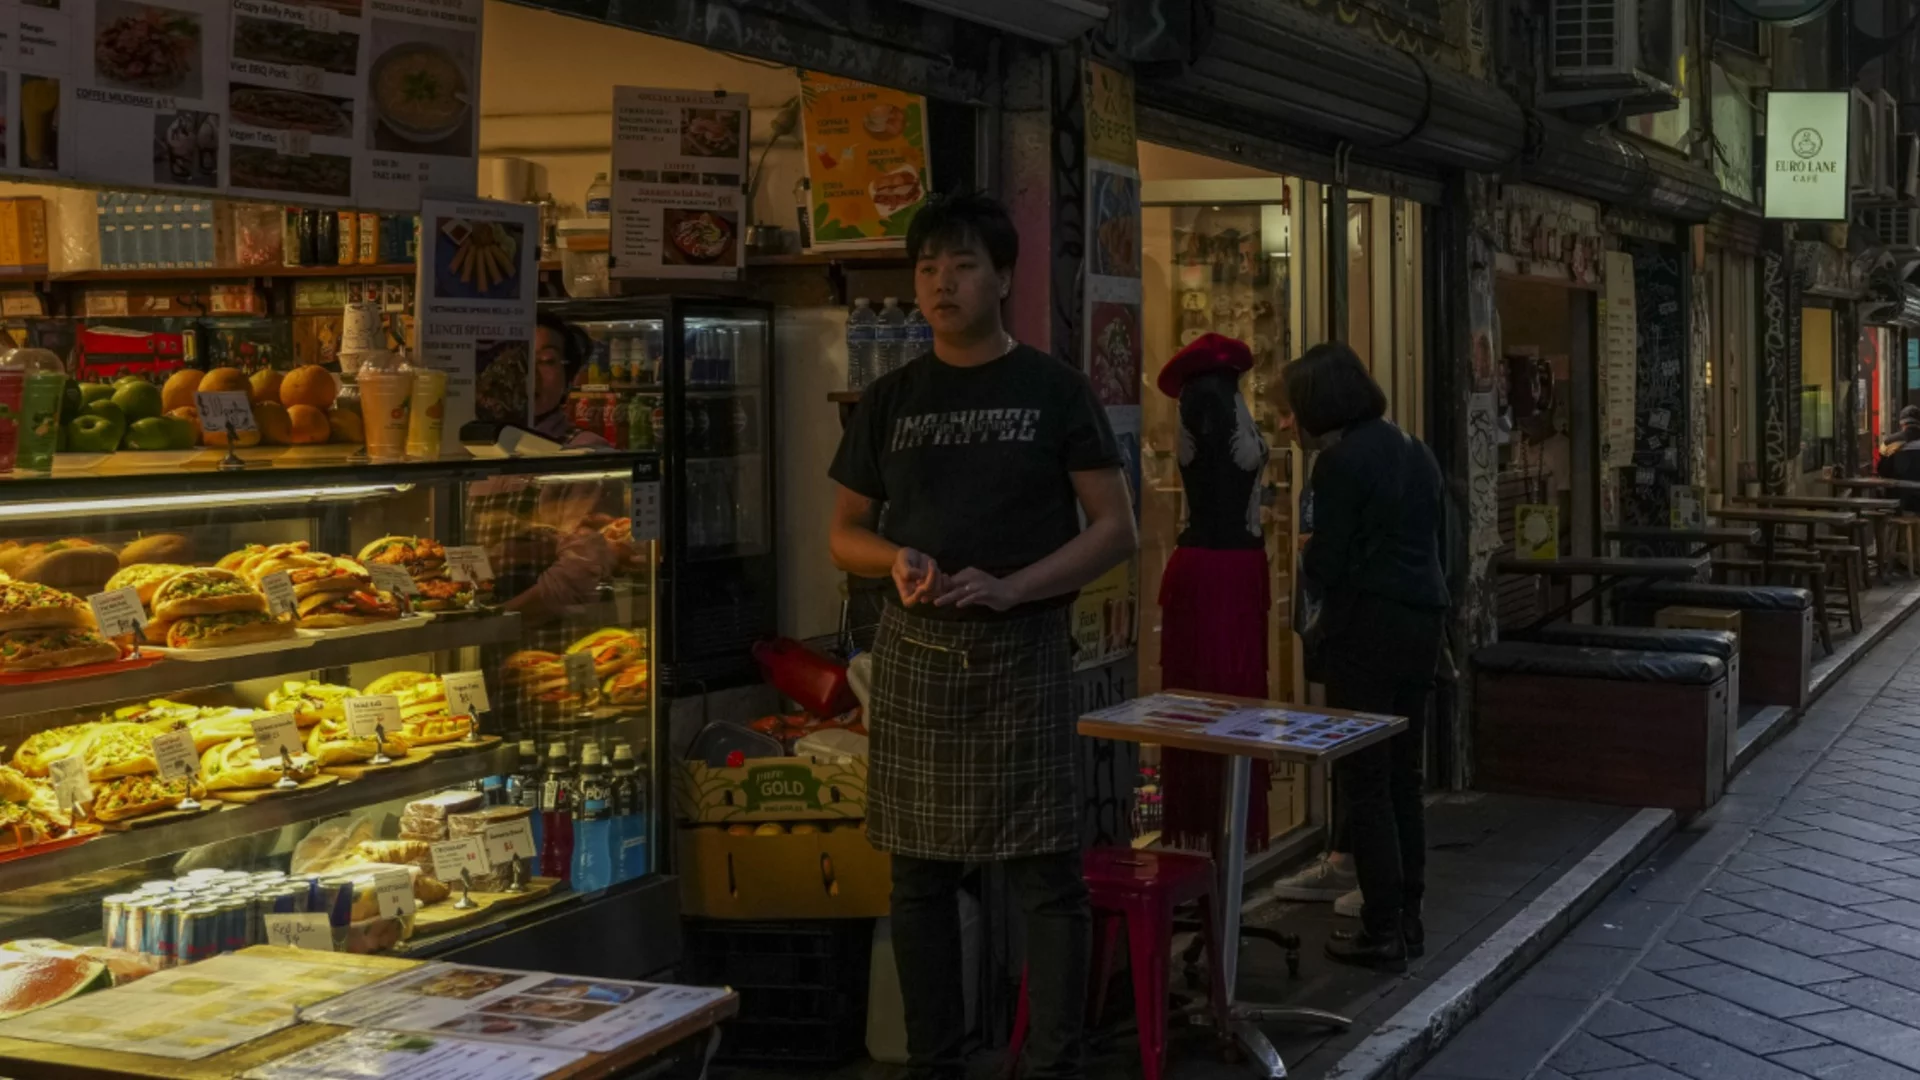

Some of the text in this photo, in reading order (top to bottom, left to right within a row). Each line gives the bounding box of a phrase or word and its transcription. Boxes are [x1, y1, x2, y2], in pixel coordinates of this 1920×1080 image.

[1776, 160, 1837, 173] EURO LANE
[429, 323, 462, 335] LUNCH
[761, 780, 805, 796] GOLD
